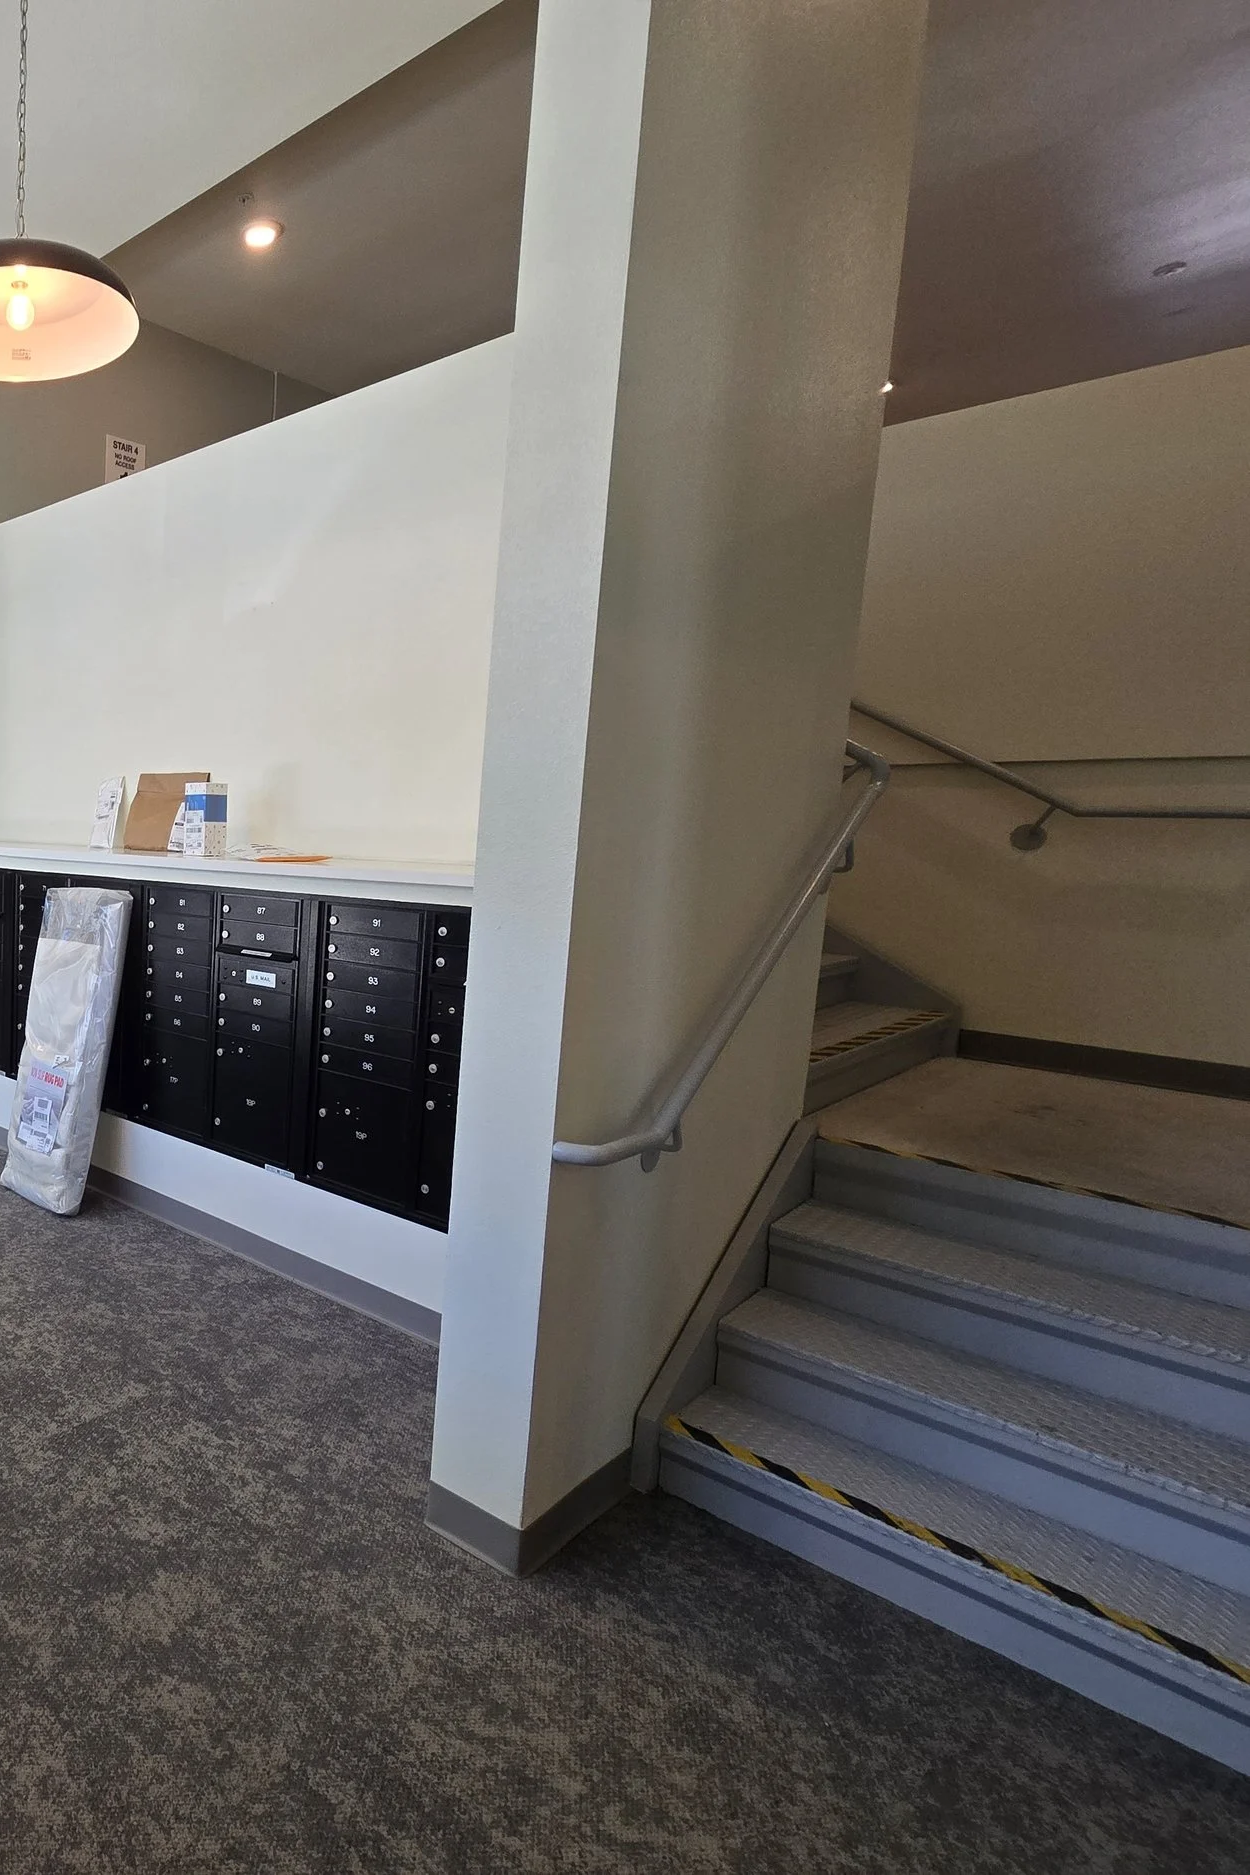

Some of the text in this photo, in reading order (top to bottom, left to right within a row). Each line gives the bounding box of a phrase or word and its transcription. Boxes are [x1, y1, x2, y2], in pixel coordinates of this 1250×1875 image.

[113, 440, 139, 455] STAIR 4
[123, 455, 137, 464] ROOF
[115, 460, 135, 470] ACCESS
[256, 906, 266, 915] 87
[177, 922, 185, 931] 82
[372, 918, 381, 928] 91
[256, 932, 265, 942] 88
[176, 947, 185, 955] 83
[369, 947, 380, 957] 92
[175, 970, 183, 979] 84
[367, 976, 379, 986] 93
[252, 997, 262, 1006] 89
[365, 1005, 376, 1014] 94
[251, 1023, 261, 1032] 90
[364, 1033, 375, 1043] 95
[362, 1061, 373, 1071] 96
[44, 1071, 54, 1085] RUG
[54, 1075, 64, 1088] PAD
